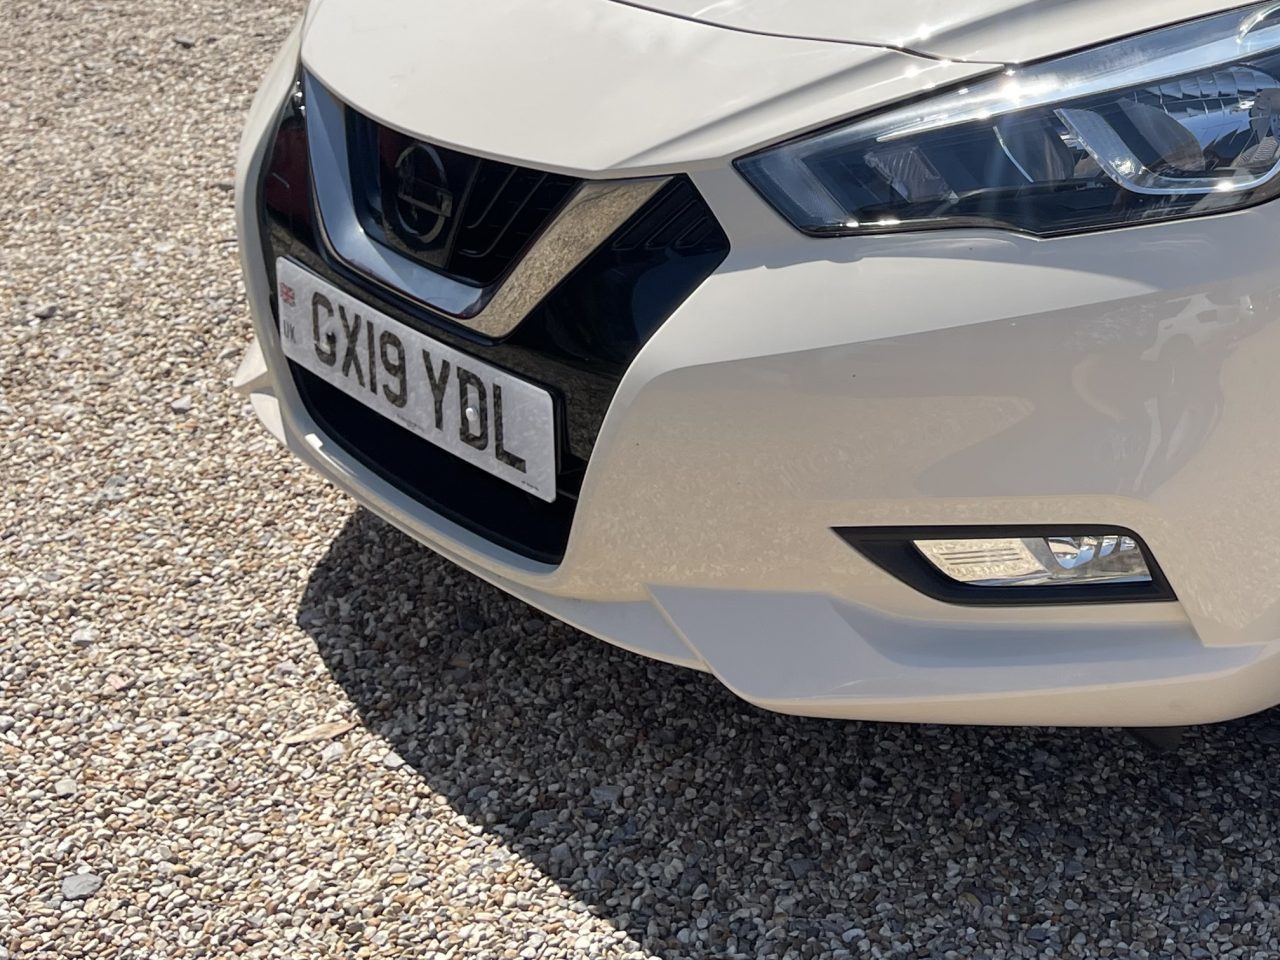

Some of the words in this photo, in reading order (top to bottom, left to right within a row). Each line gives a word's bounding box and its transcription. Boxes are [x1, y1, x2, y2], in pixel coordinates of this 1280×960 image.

[283, 319, 296, 344] UK
[311, 291, 407, 409] GX19
[422, 348, 527, 474] YDL
